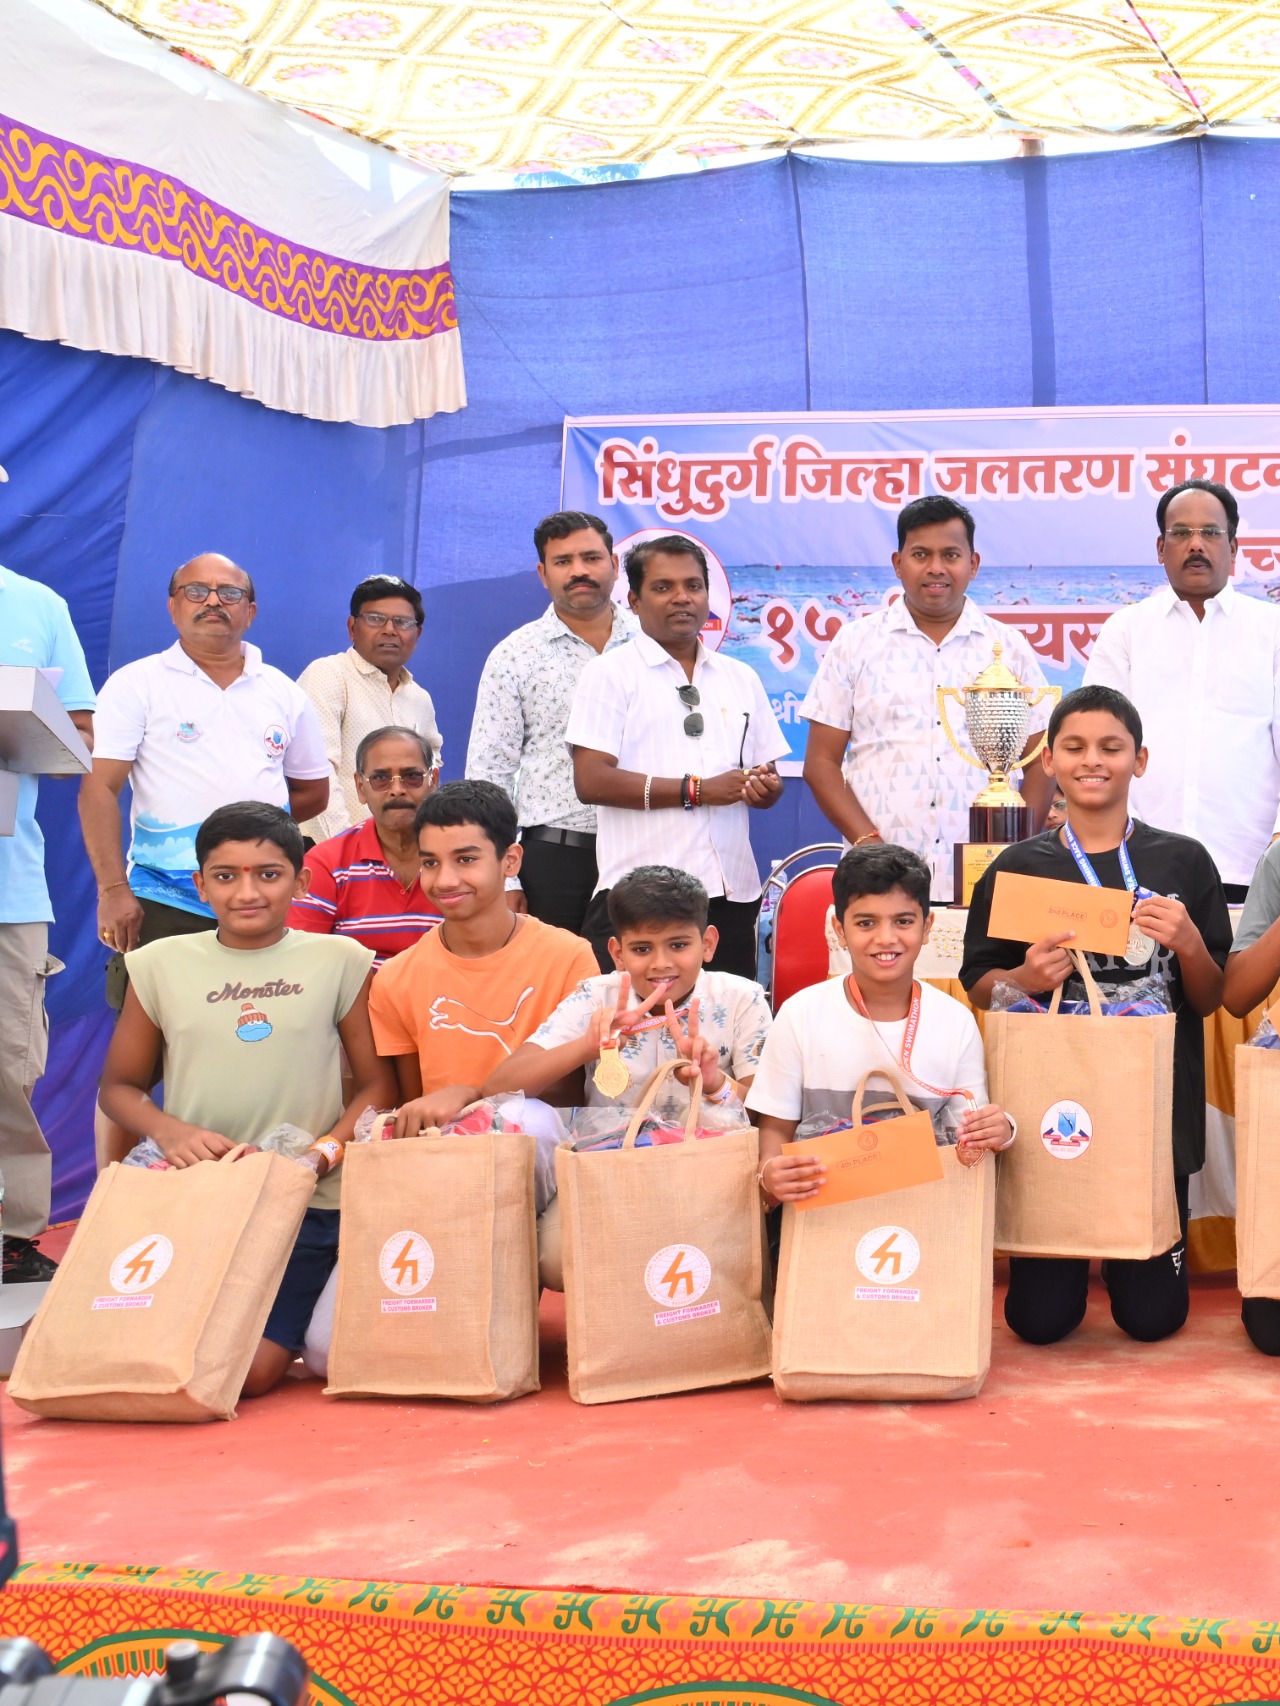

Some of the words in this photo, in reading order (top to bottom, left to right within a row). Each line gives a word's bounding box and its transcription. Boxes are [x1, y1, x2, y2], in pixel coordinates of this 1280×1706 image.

[601, 441, 774, 516] सिंधुदुर्ग
[783, 440, 924, 504] जिल्हा
[935, 454, 1134, 494] जलतरण
[1062, 910, 1085, 920] PLACE
[207, 978, 304, 1003] Monster
[905, 998, 919, 1049] SWIMATHON
[852, 1153, 878, 1166] PLACE
[656, 1310, 681, 1318] FREIGHT
[682, 1302, 718, 1314] FORWARDER
[662, 1314, 691, 1323] CUSTOMS
